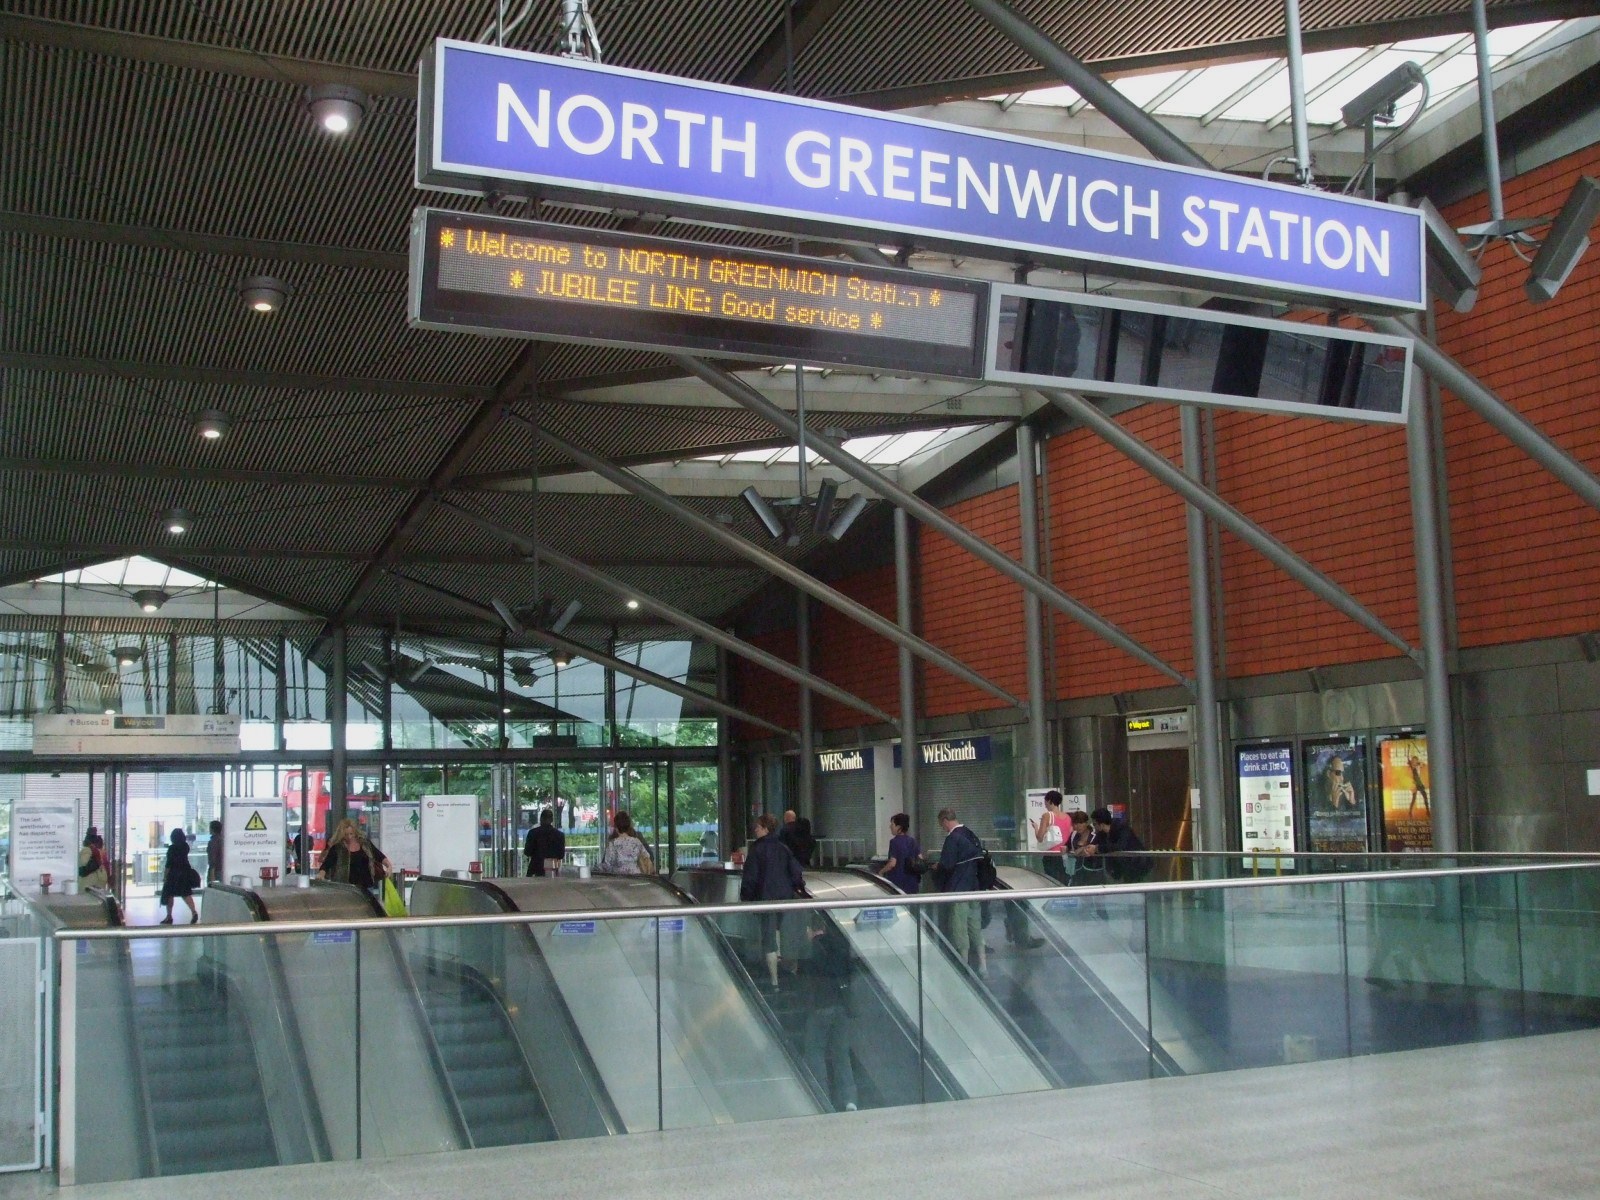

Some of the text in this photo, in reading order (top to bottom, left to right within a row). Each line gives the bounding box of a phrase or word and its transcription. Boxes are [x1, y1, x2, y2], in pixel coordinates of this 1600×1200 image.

[495, 82, 1391, 278] NORTH GREENWICH STATION
[466, 229, 571, 265] Welcome
[584, 245, 607, 269] to
[619, 248, 699, 279] NORTH
[709, 258, 837, 297] GREENWICH
[536, 269, 860, 330] JUBILEE LINE: Good service
[76, 718, 99, 726] Buses
[819, 751, 864, 771] WHSmith
[923, 741, 977, 763] WHSmith
[1240, 751, 1259, 760] Places
[1260, 752, 1267, 760] to
[1267, 752, 1278, 760] eat
[1243, 762, 1260, 772] drink
[1261, 763, 1268, 771] at
